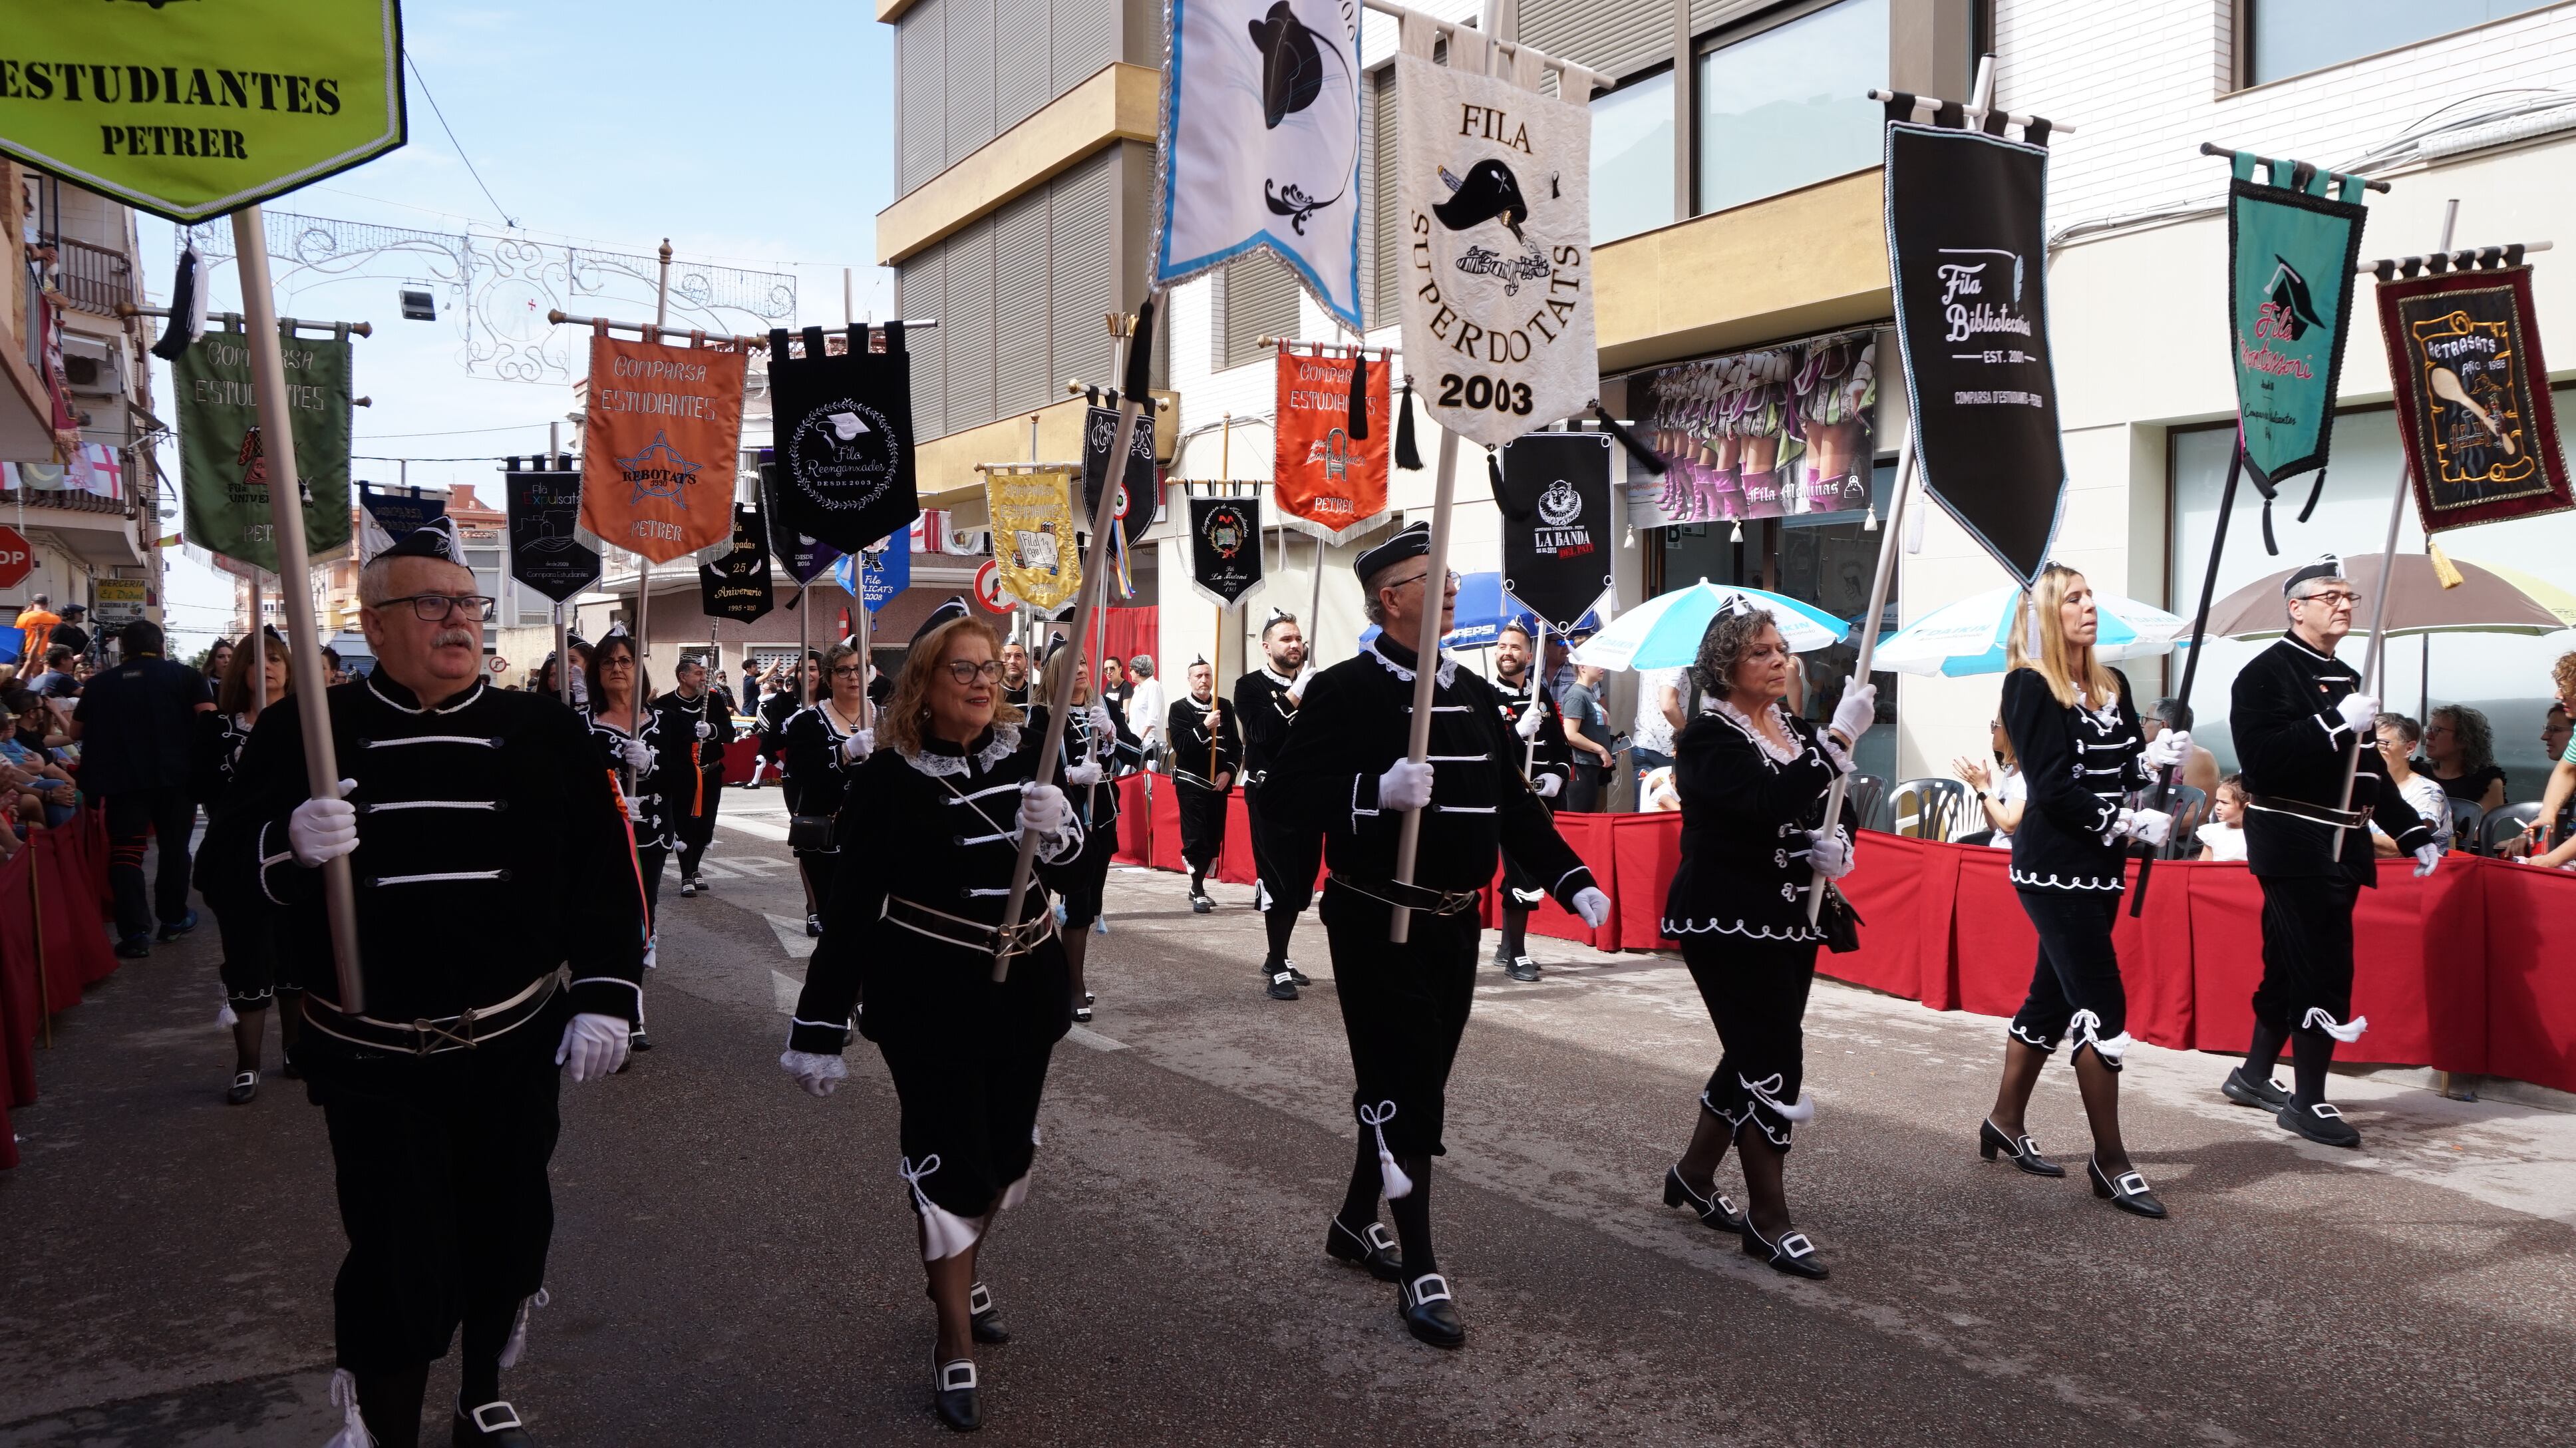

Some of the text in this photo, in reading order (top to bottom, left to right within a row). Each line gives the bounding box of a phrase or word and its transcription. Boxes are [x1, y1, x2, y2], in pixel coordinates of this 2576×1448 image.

[0, 60, 341, 116] ESTUDIANTES
[1459, 103, 1533, 155] FILA
[101, 124, 249, 160] PETRER
[1410, 208, 1581, 364] SUPERDOTATS
[1937, 263, 1987, 305] Fila
[208, 341, 313, 371] COMRSA
[2428, 335, 2496, 359] RETRASATS
[1983, 350, 2007, 363] EST.
[614, 355, 707, 383] COMPARSA
[1300, 362, 1369, 384] COMPAR
[2462, 360, 2481, 376] AÑO
[196, 379, 325, 411] ESTUDTES
[1438, 373, 1533, 417] 2003
[602, 389, 717, 421] ESTUDIANTES
[833, 445, 863, 463] Fila
[804, 459, 886, 477] Reenganxades
[533, 482, 548, 494] Filà
[1748, 480, 1839, 504] Fila Meninas
[1315, 496, 1355, 514] PETRER
[244, 524, 273, 542] PET
[631, 519, 683, 542] PETRER
[1535, 530, 1591, 548] LA BANDA
[1022, 533, 1039, 547] Fila
[0, 551, 25, 565] OP
[557, 570, 589, 578] Estudiantes
[732, 562, 746, 573] 25
[98, 579, 146, 588] MERCERIA
[865, 575, 882, 585] Fila
[715, 586, 762, 599] Aniversario
[1455, 624, 1496, 639] PEPSI
